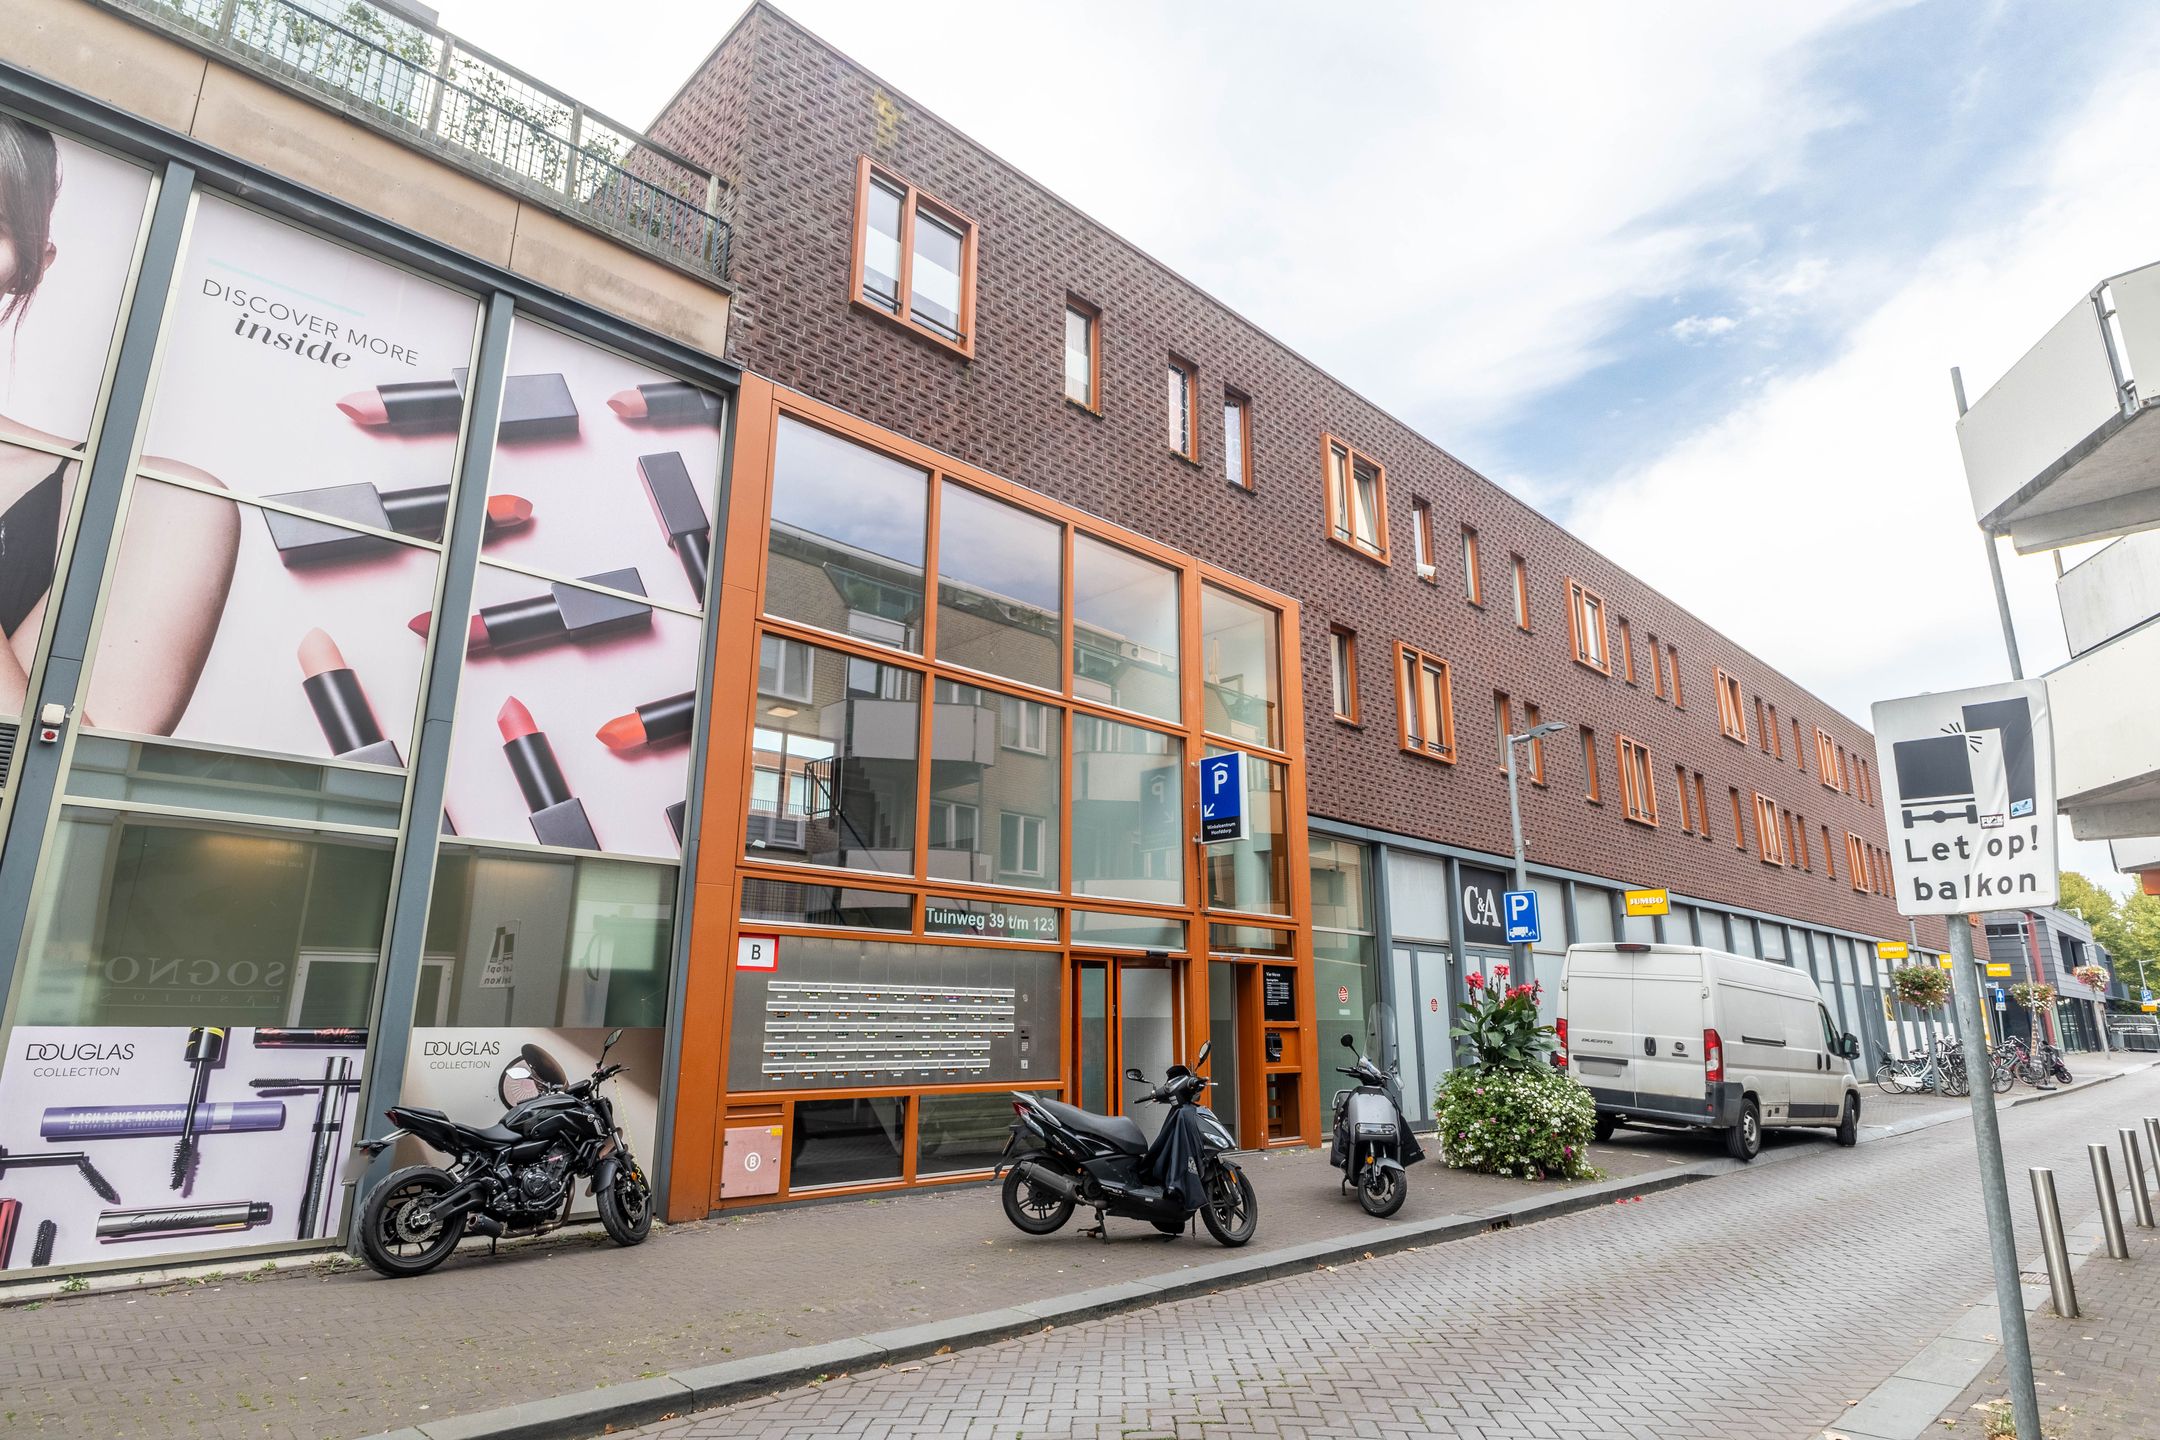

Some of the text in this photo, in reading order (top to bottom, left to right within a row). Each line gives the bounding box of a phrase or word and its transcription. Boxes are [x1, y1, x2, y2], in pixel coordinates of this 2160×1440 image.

[202, 278, 419, 367] DISCOVER MORE
[234, 312, 352, 369] inside
[1214, 769, 1228, 795] P
[1904, 824, 2038, 863] Let op!
[1913, 872, 2036, 901] balkon
[1463, 885, 1502, 928] C&A
[1510, 894, 1529, 921] P
[1630, 896, 1665, 905] JUMBO
[925, 907, 1055, 932] Tuinweg 39 t/m 123
[751, 944, 761, 960] B
[25, 1043, 136, 1061] DOUGLAS
[423, 1041, 501, 1056] DOUGLAS
[33, 1066, 120, 1078] COLLECTION
[429, 1060, 491, 1070] COLLECTION
